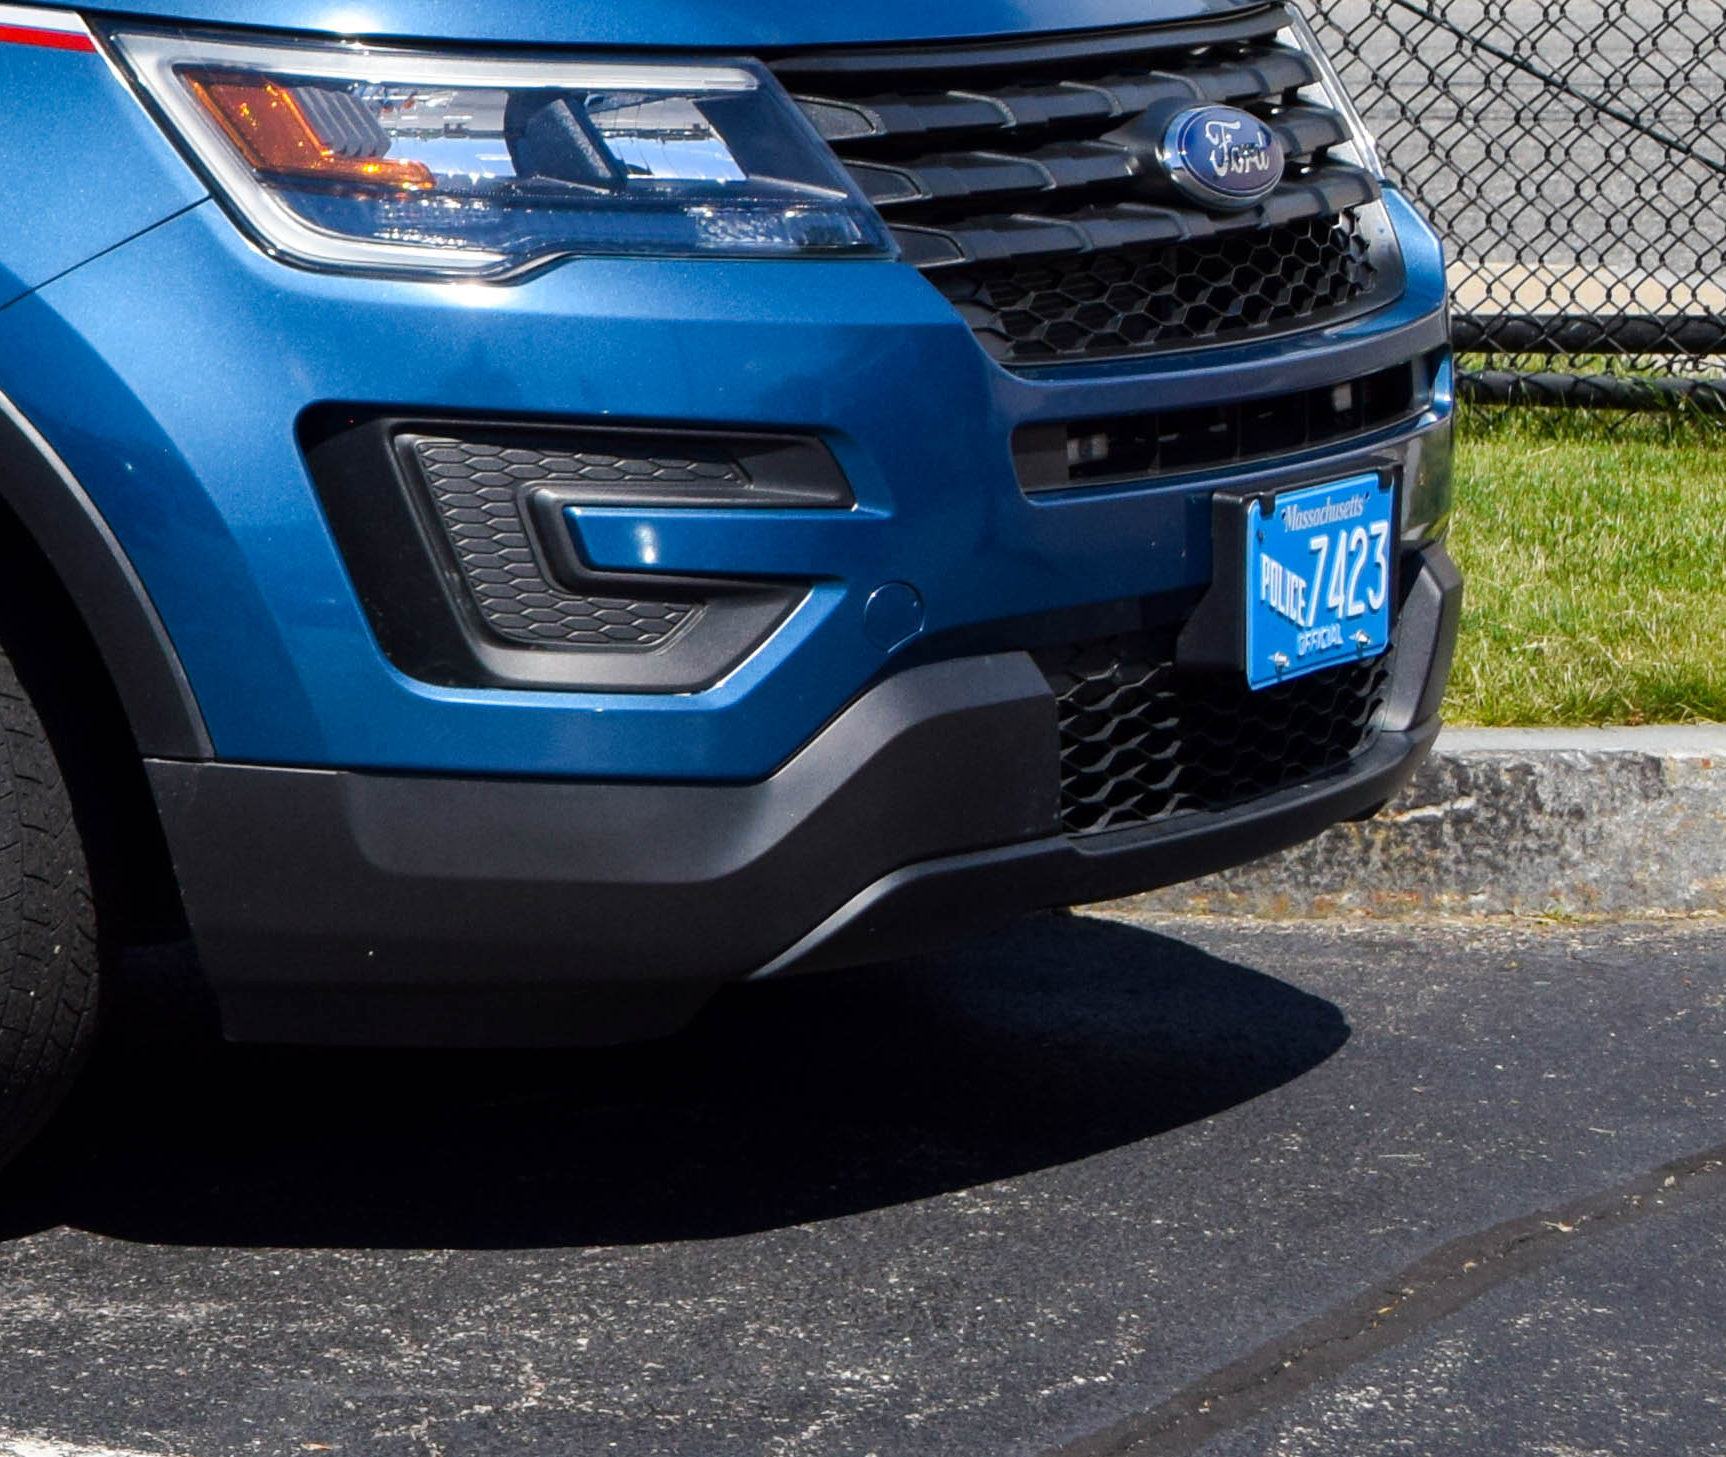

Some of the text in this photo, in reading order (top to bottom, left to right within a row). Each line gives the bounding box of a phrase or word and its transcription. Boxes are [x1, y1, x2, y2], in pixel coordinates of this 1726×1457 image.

[1205, 121, 1270, 177] Ford
[1283, 495, 1365, 533] Massachusetts
[1260, 520, 1389, 628] POLICE 7423
[1298, 623, 1344, 656] OFFICIAL
